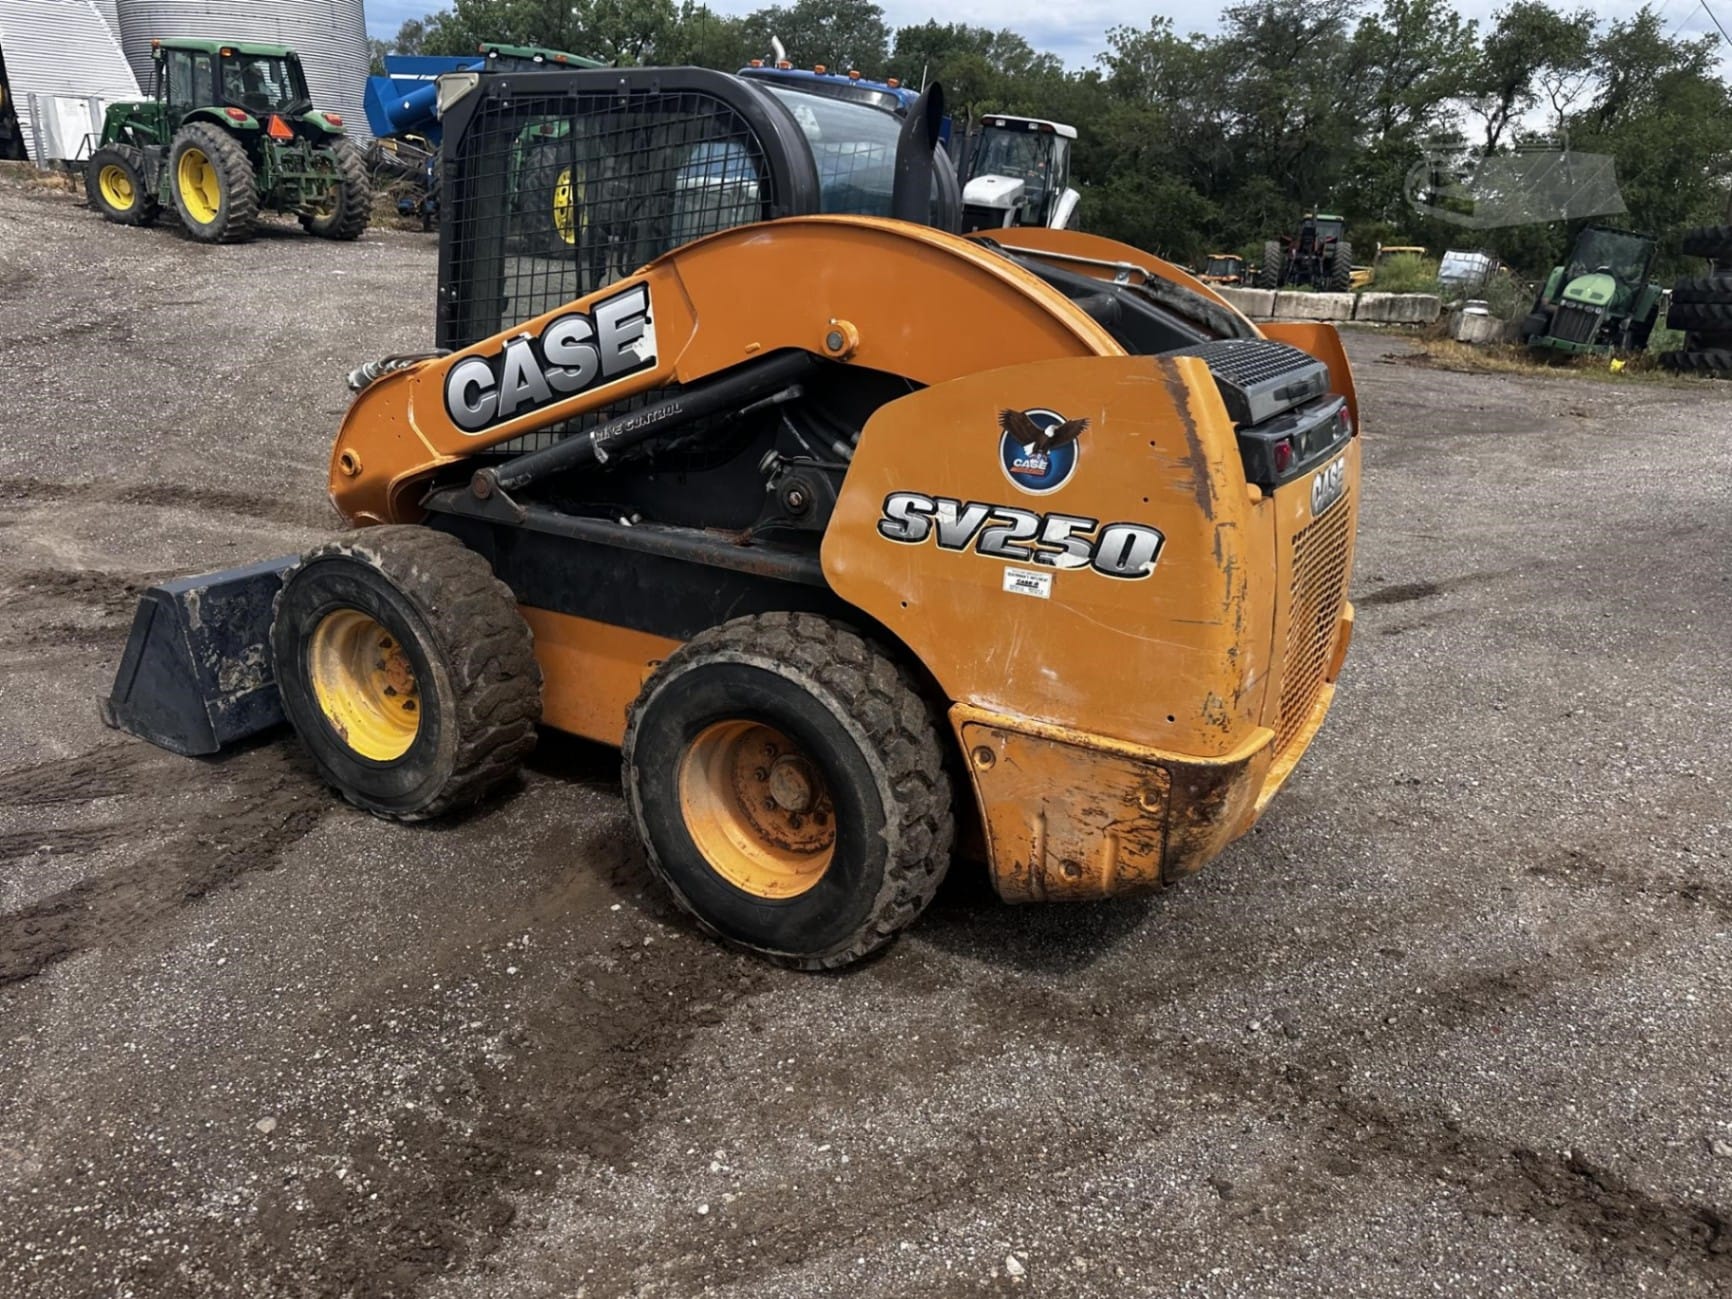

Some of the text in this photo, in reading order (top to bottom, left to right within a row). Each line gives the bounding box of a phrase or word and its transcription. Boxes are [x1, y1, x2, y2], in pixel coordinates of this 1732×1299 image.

[446, 285, 650, 429] CASE
[1012, 458, 1048, 470] CASE
[1311, 456, 1345, 515] CASE
[878, 492, 1165, 580] SV250
